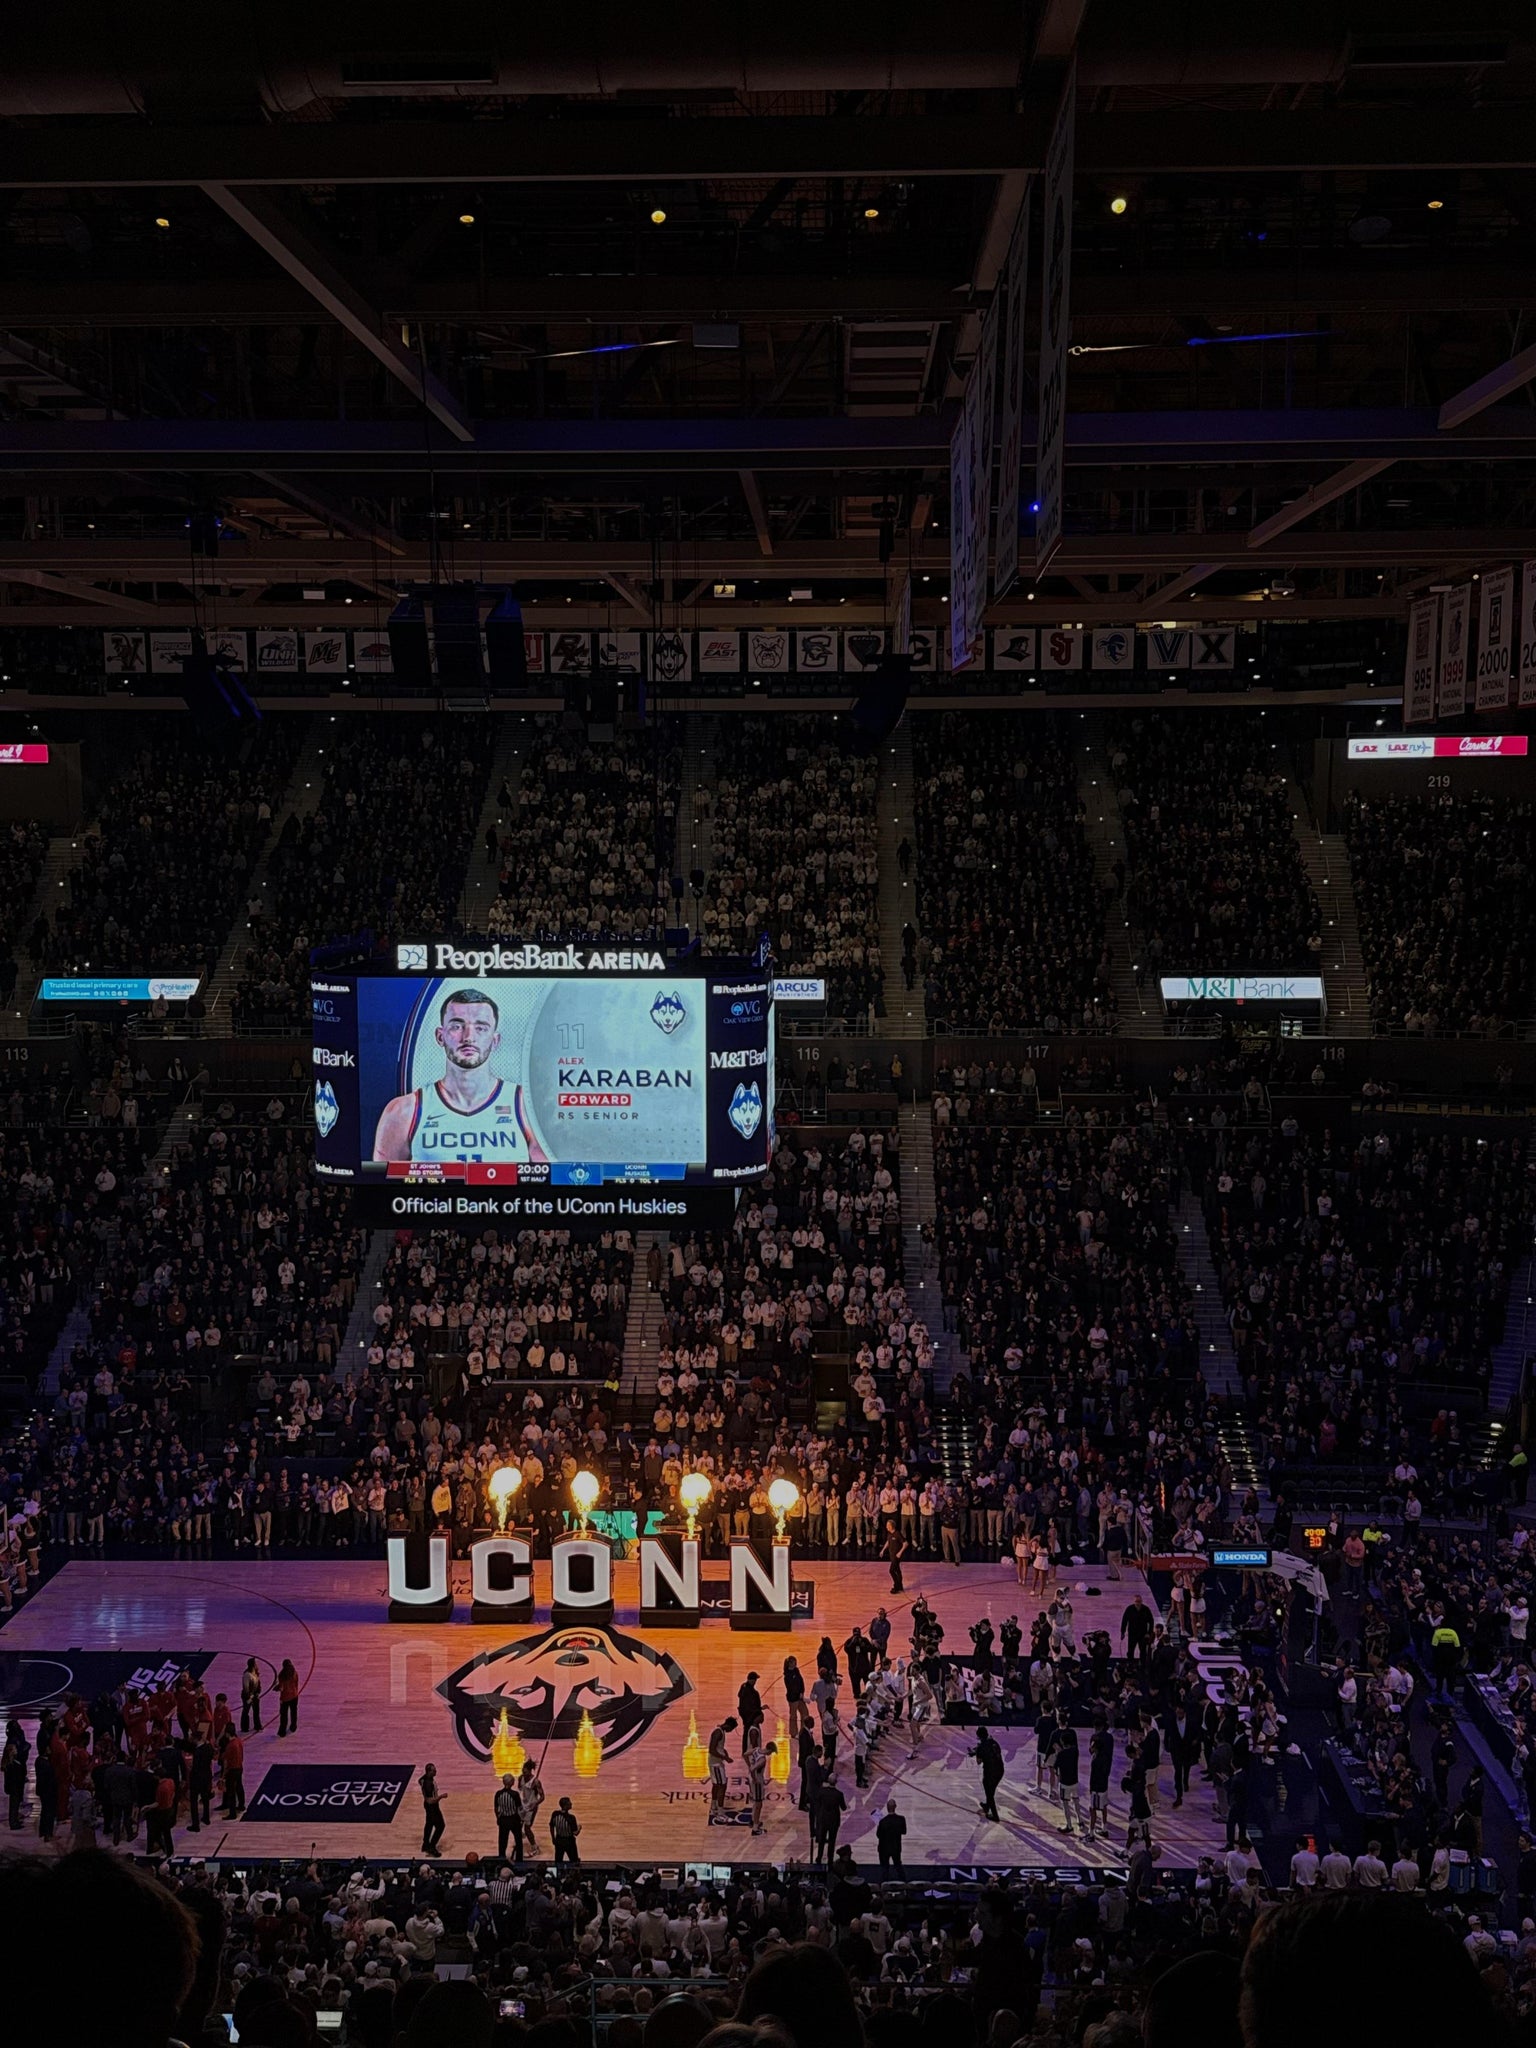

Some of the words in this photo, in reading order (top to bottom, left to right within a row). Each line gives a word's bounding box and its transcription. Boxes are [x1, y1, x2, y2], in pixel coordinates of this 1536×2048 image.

[708, 642, 732, 650] BIG
[1153, 633, 1186, 665] V
[1200, 633, 1230, 664] X
[1479, 650, 1509, 676] 2000
[1443, 659, 1464, 685] 1999
[1428, 776, 1450, 787] 219
[435, 944, 585, 977] PeoplesBank
[588, 952, 666, 970] ARENA
[94, 982, 122, 990] primary
[161, 983, 195, 991] ProHealth
[775, 982, 818, 992] ARCUS
[1188, 978, 1241, 998] M&T
[1243, 978, 1296, 998] Bank
[557, 1023, 584, 1049] 11
[5, 1048, 29, 1061] 113
[322, 1049, 355, 1067] Bank
[797, 1047, 820, 1060] 116
[1026, 1045, 1049, 1059] 117
[1321, 1047, 1345, 1060] 118
[558, 1057, 584, 1065] ALEX
[710, 1051, 749, 1069] M&T
[558, 1069, 692, 1087] KARABAN
[560, 1095, 629, 1104] FORWARD
[558, 1112, 574, 1120] RS
[584, 1112, 639, 1120] SENIOR
[422, 1131, 516, 1149] UCONN
[487, 1168, 496, 1179] 0
[517, 1164, 549, 1174] 20:00
[576, 1169, 585, 1179] 0
[392, 1197, 453, 1214] Official
[457, 1197, 499, 1213] Bank
[503, 1197, 522, 1213] of
[524, 1197, 553, 1214] the
[557, 1197, 615, 1214] UConn
[619, 1197, 687, 1214] Huskies
[1304, 1528, 1326, 1537] 20:00
[1309, 1537, 1322, 1547] 30
[1224, 1553, 1267, 1561] HONDA
[387, 1537, 791, 1613] UCONN
[330, 1781, 402, 1794] REED
[257, 1794, 397, 1806] MADISON
[949, 1867, 1133, 1882] NISSAN
